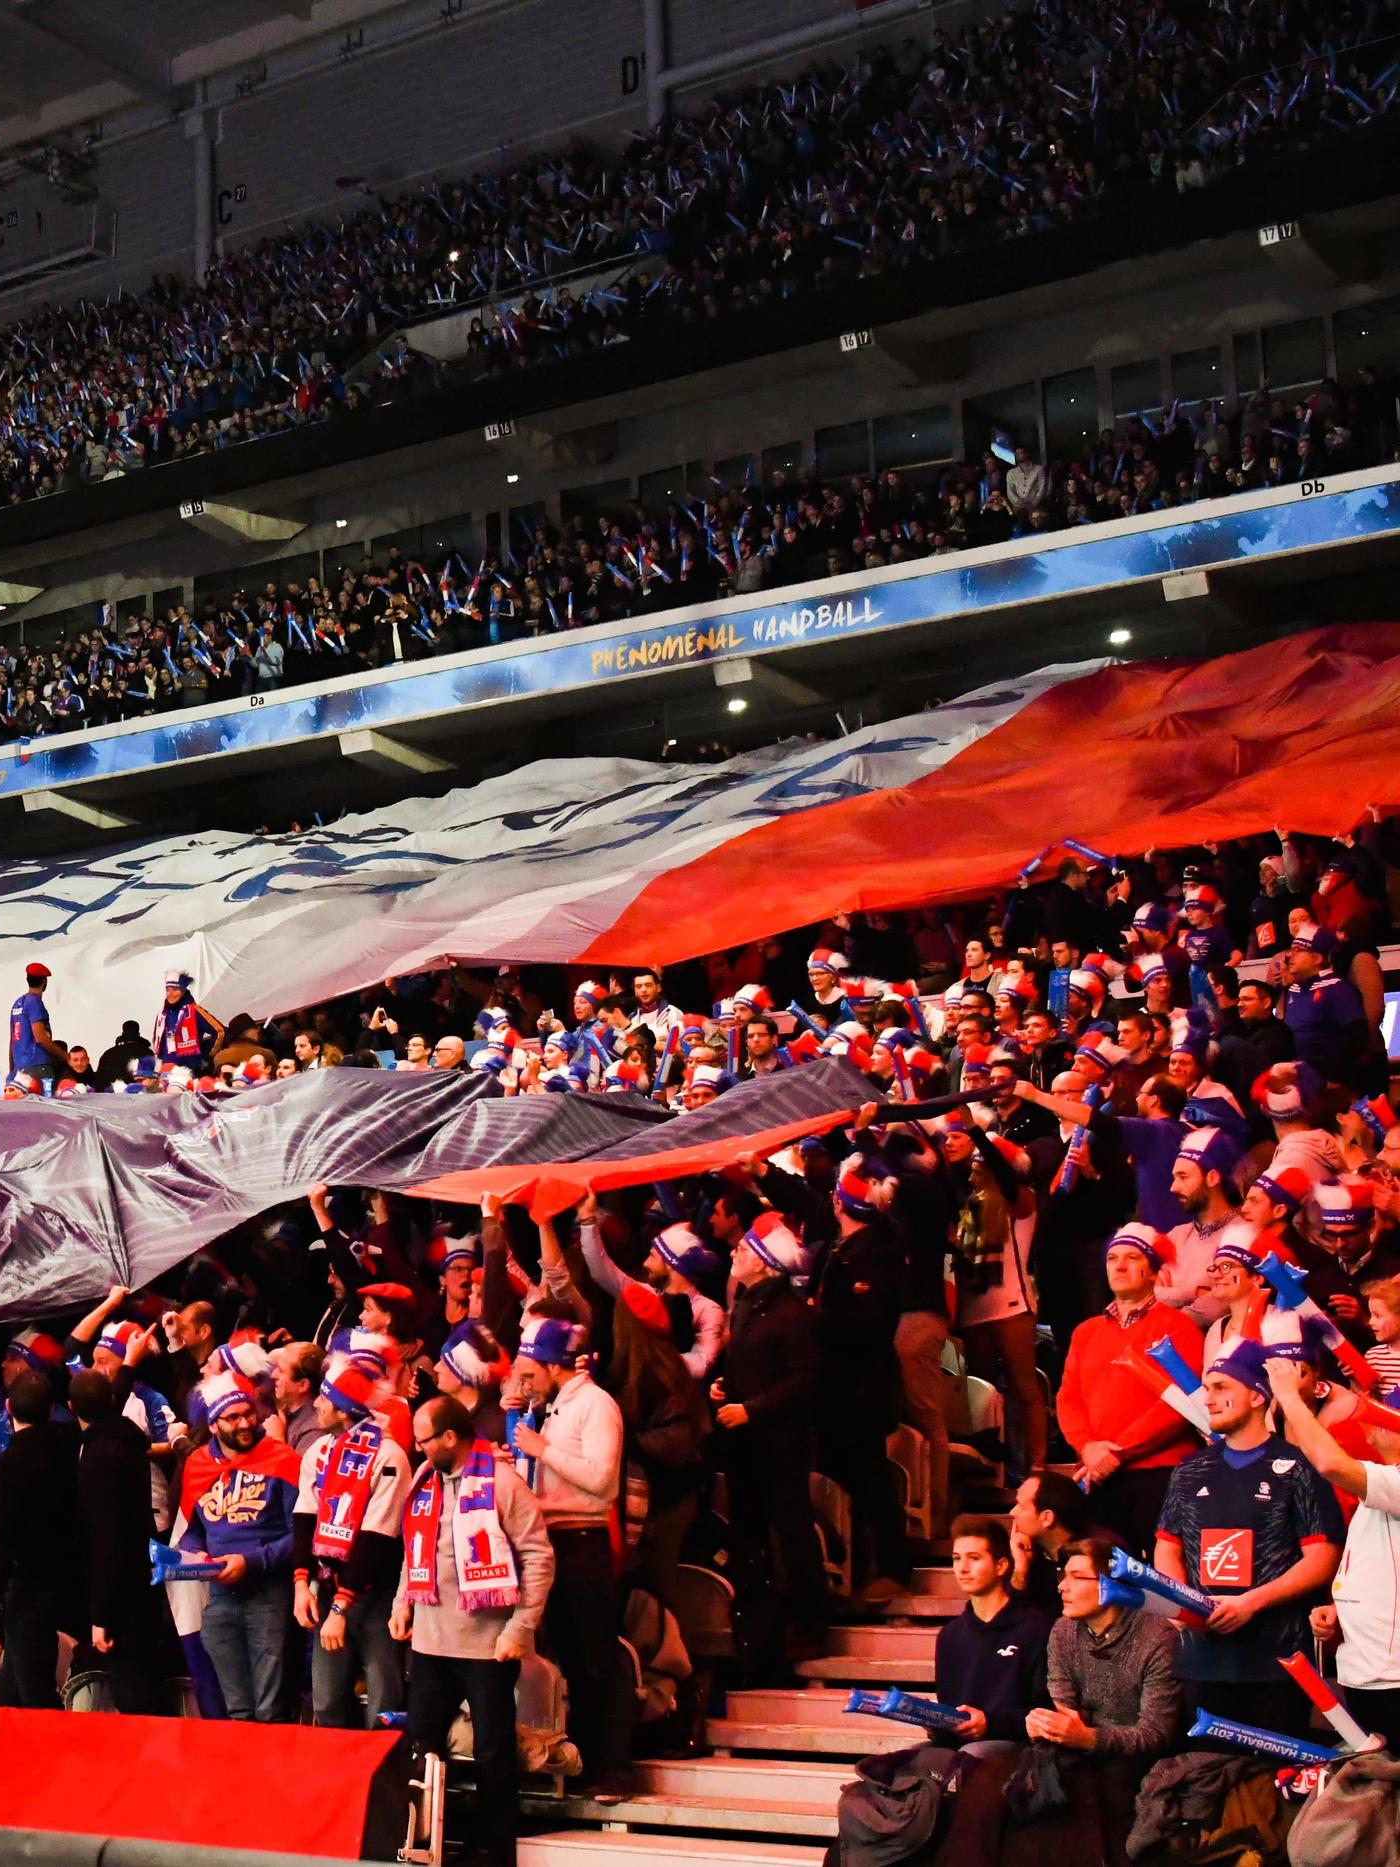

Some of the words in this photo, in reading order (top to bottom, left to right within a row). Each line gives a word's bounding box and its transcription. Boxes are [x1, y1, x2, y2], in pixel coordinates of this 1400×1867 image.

[218, 190, 232, 225] C
[1301, 479, 1325, 496] Db
[752, 597, 885, 642] HANDBALL
[250, 696, 265, 707] Da
[320, 1526, 351, 1540] FRANCE
[1206, 1725, 1233, 1741] 2017
[1236, 1733, 1298, 1758] HANDBALL
